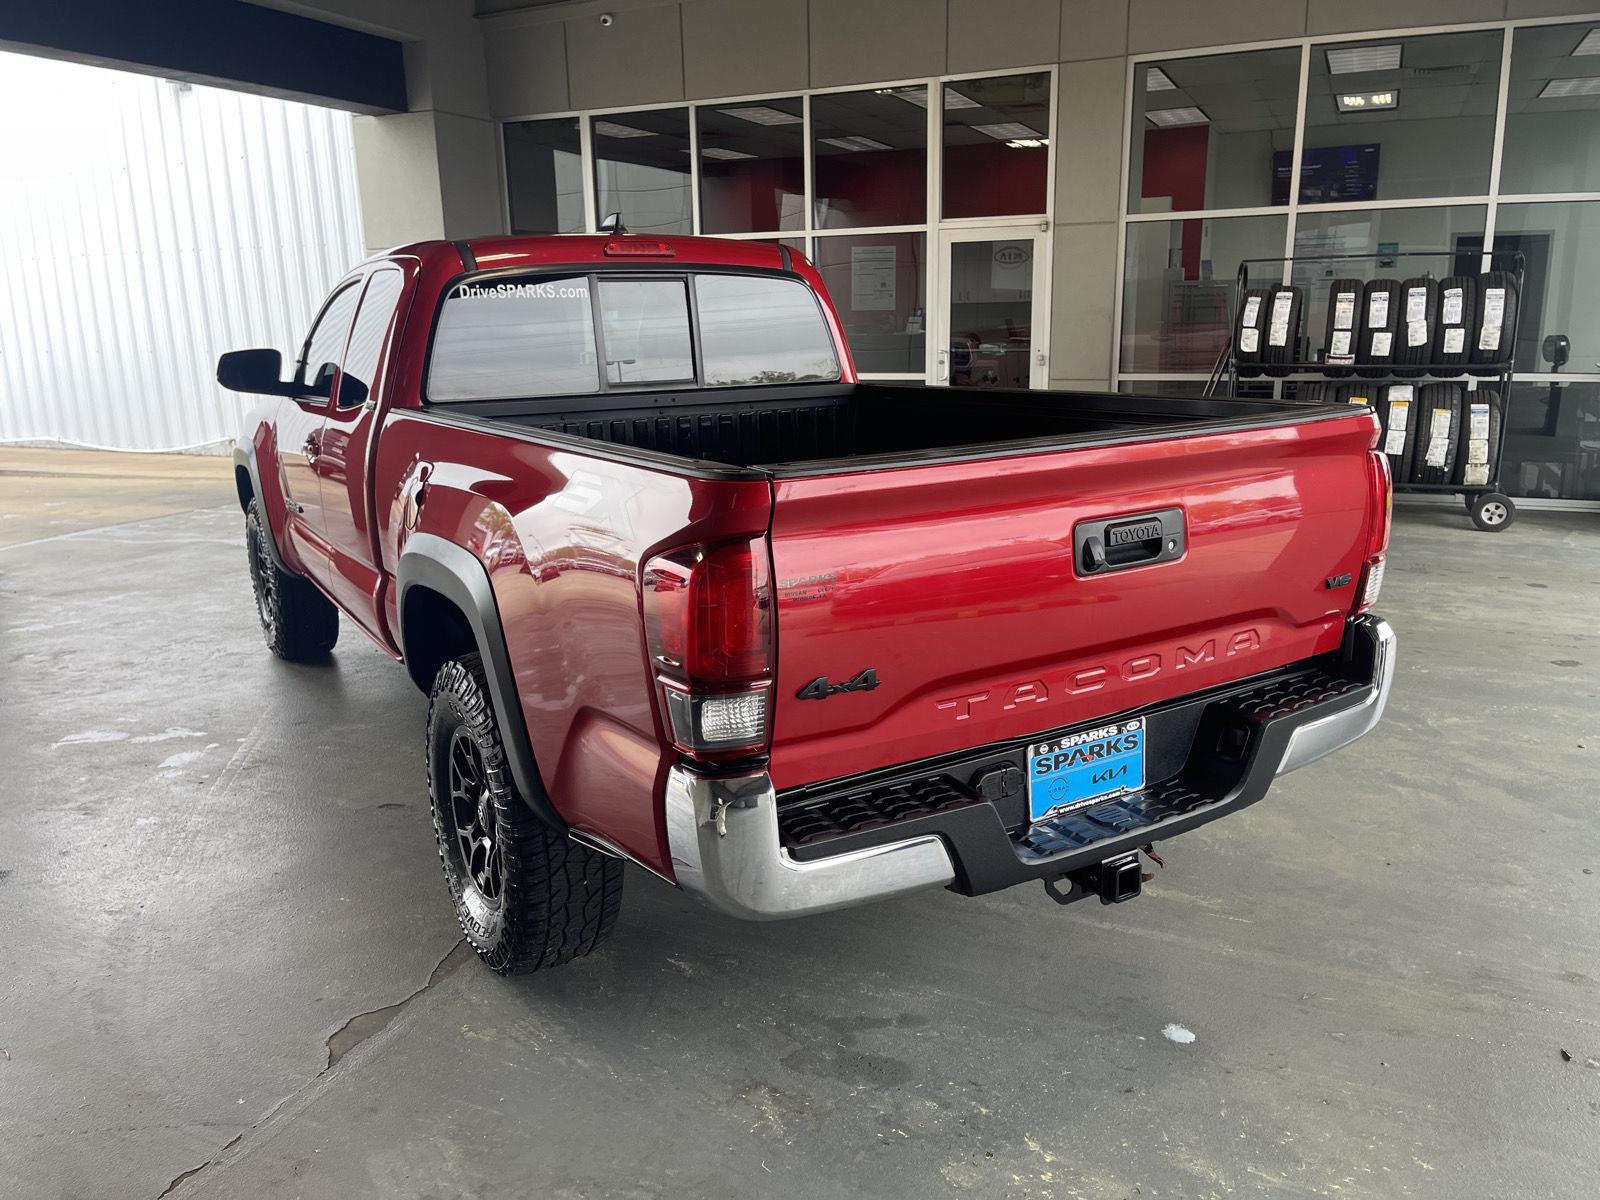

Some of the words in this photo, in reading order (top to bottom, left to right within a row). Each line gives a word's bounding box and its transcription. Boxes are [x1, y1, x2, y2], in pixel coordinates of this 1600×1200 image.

[459, 284, 588, 299] DriveSPARKS.com
[1112, 524, 1161, 544] TOYOTA
[1325, 573, 1352, 590] V6
[795, 667, 882, 701] 4x4
[935, 628, 1261, 720] TACOMA
[1060, 725, 1118, 749] SPARKS
[1035, 733, 1139, 775] SPARKS
[1092, 764, 1128, 785] KIA
